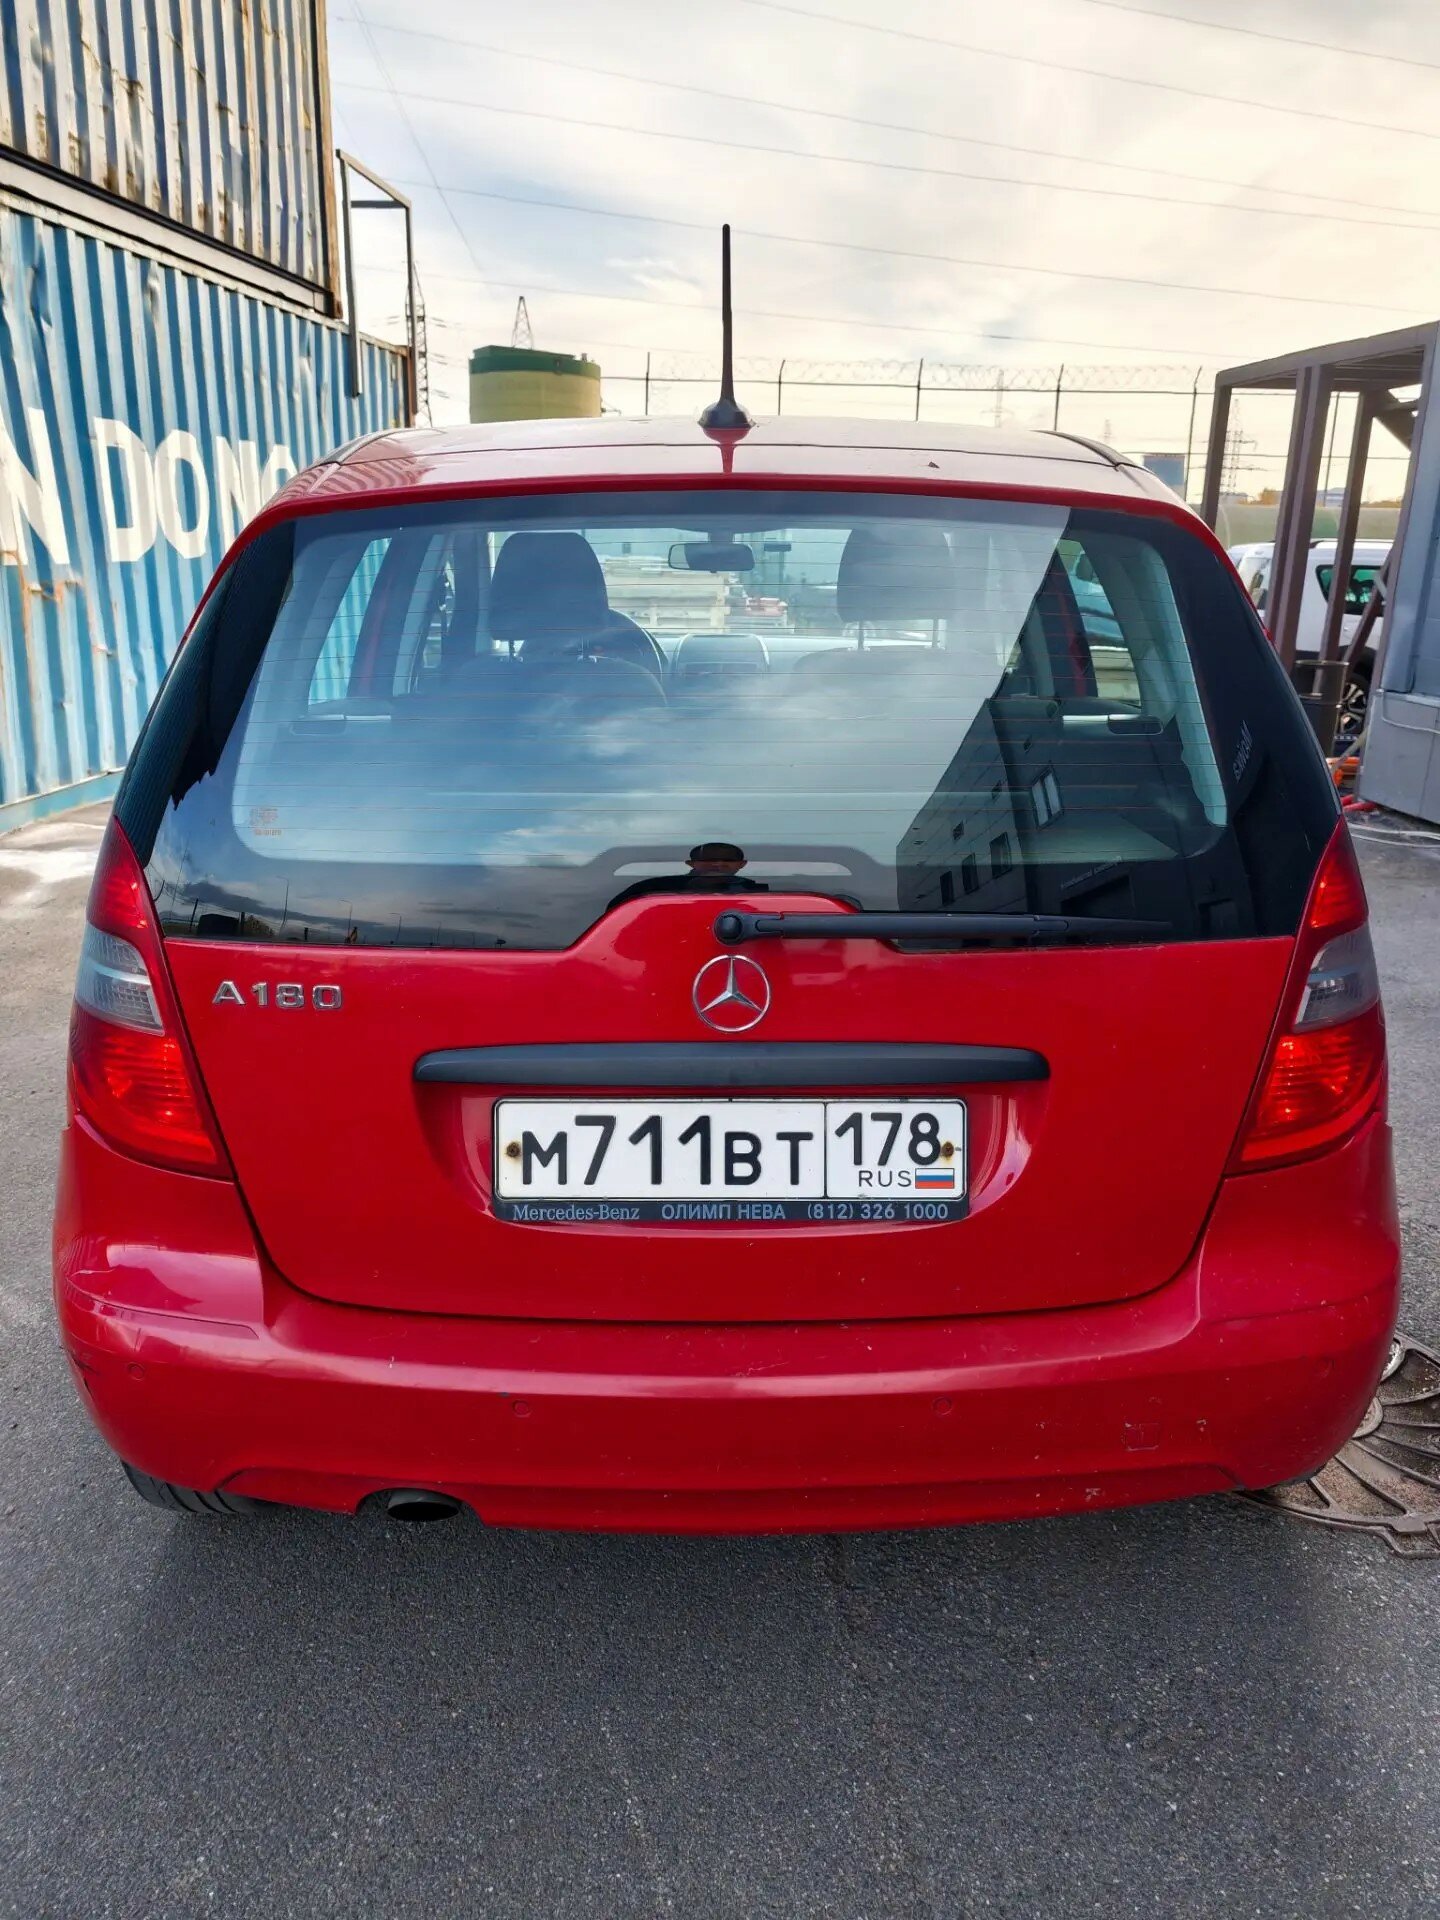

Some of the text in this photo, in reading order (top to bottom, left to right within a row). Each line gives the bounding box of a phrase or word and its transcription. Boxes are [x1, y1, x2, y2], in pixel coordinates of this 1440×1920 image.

[212, 980, 343, 1011] A180
[834, 1112, 942, 1167] 178
[858, 1170, 912, 1187] RUS
[513, 1202, 949, 1221] Mercedes-Benz ОЛИМП НЕВА (812) 326 1000
